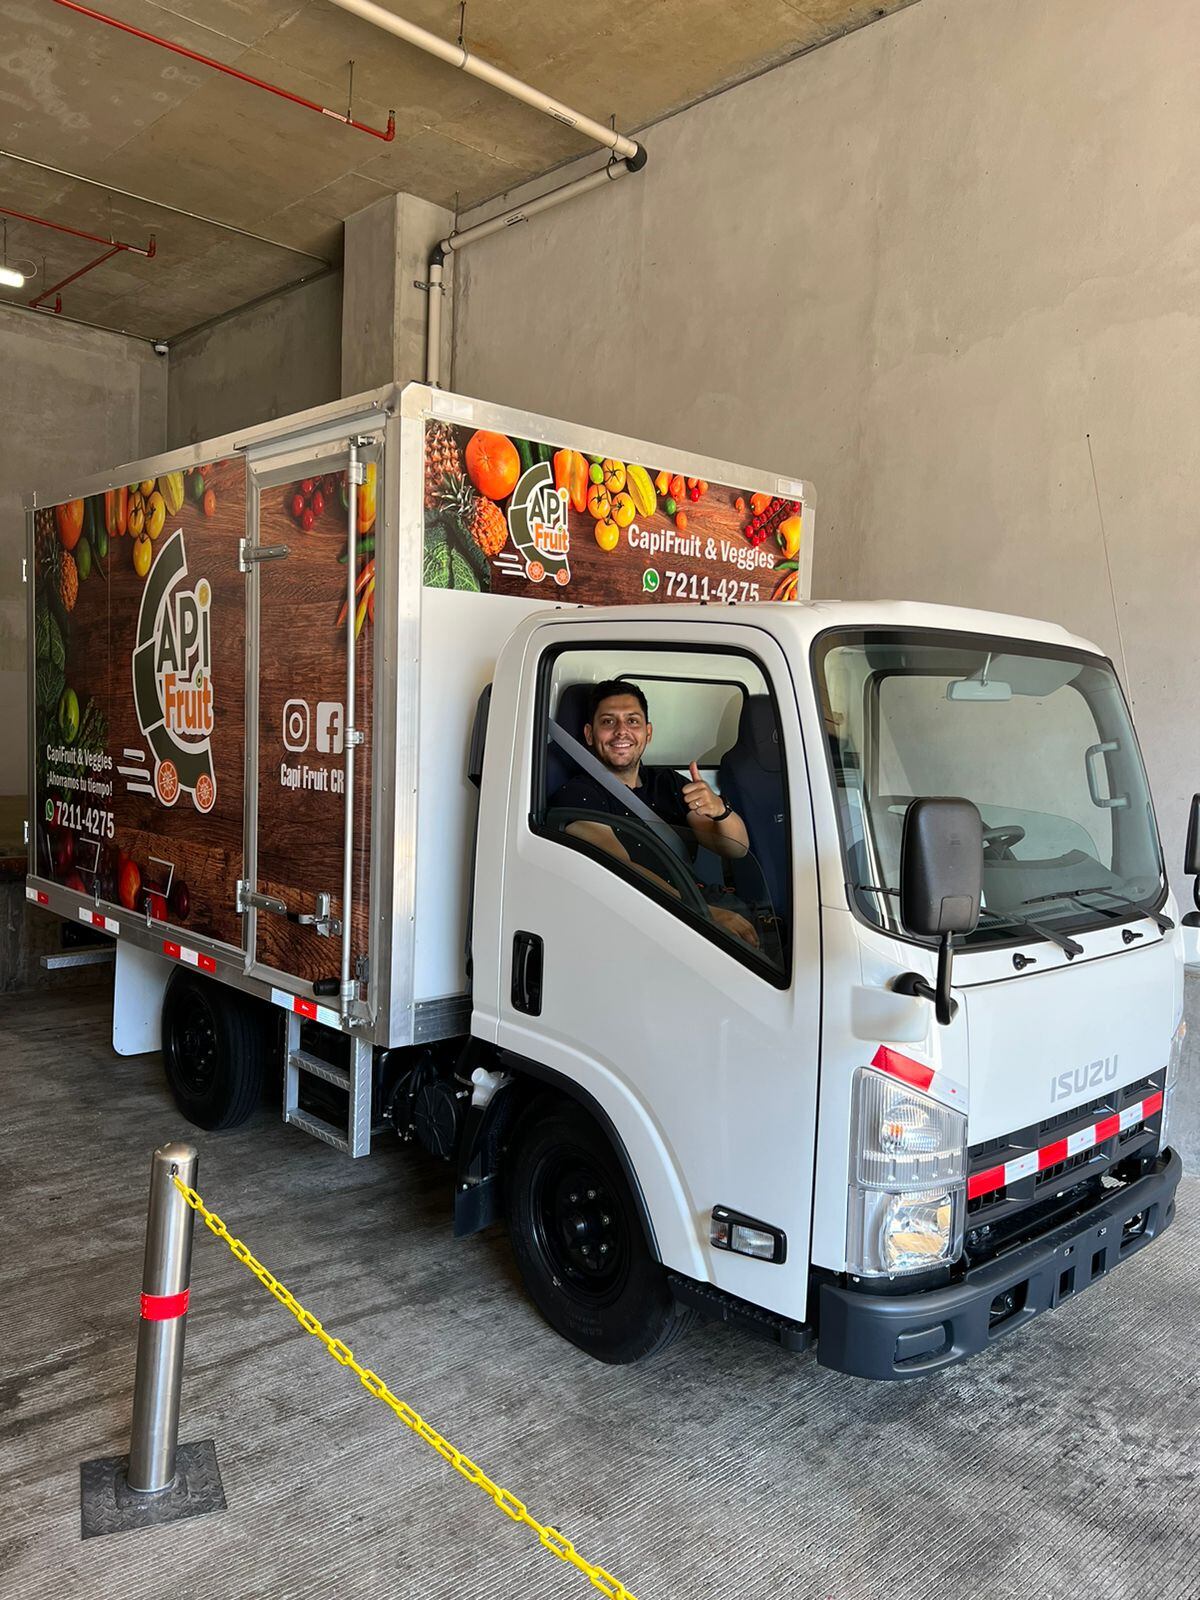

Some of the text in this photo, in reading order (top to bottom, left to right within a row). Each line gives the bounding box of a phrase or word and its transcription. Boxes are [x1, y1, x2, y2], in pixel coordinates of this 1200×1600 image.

[534, 523, 569, 552] Fruit
[627, 524, 775, 570] CapiFruit & Veggies
[665, 571, 760, 602] 7211-4275
[164, 672, 212, 731] Fruit
[46, 744, 113, 772] CapiFruit & Veggies
[80, 777, 87, 792] tu
[87, 777, 113, 798] tiempo!
[280, 763, 344, 793] Capi Fruit CR
[56, 801, 115, 839] 7211-4275
[1050, 1054, 1118, 1103] ISUZU
